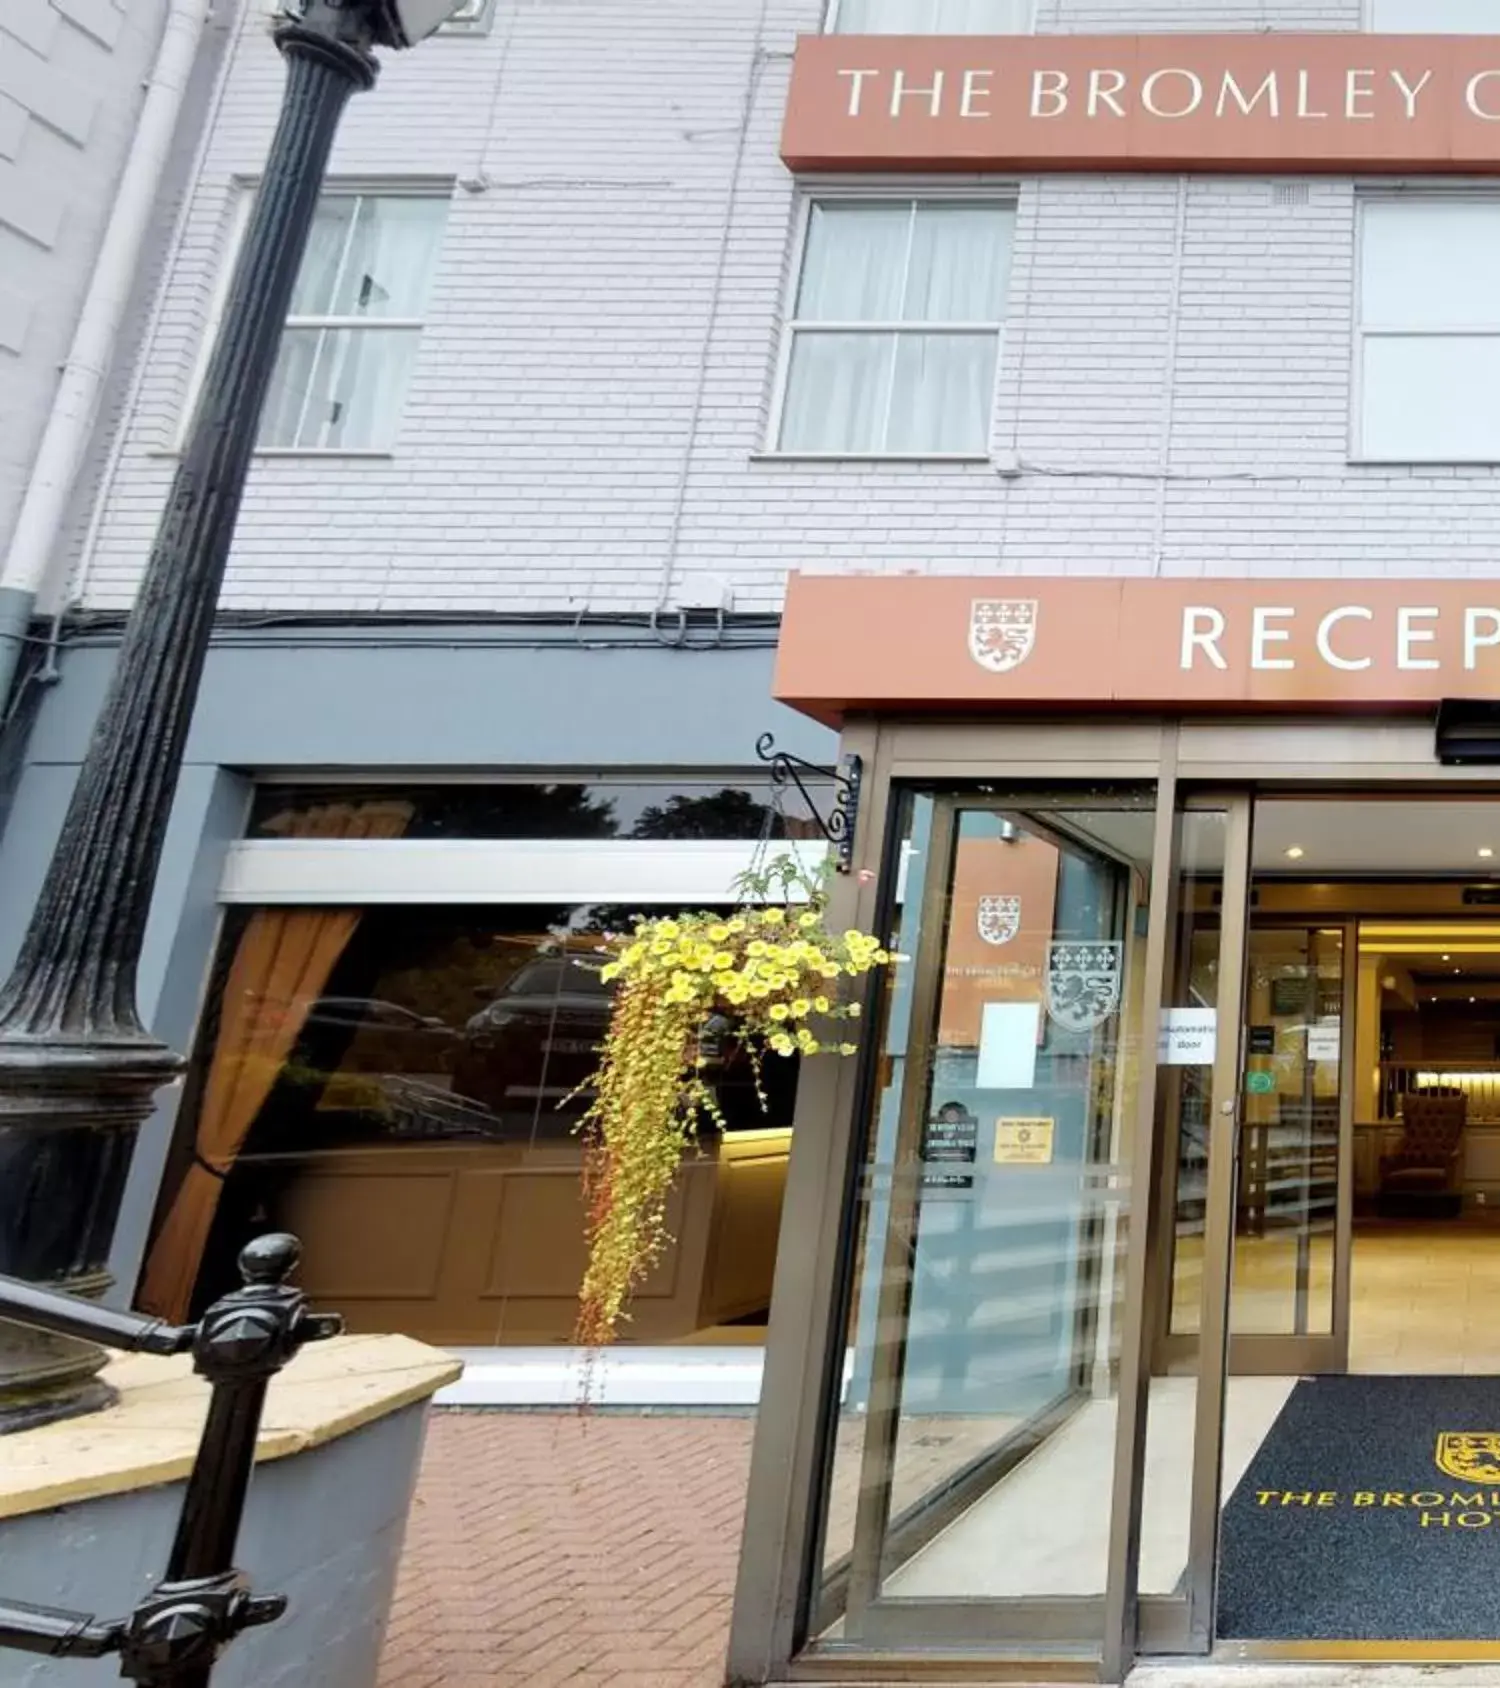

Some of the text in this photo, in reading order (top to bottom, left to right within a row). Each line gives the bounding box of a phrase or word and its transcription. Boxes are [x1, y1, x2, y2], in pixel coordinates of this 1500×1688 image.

[837, 69, 994, 117] THE
[1029, 68, 1432, 119] BROMLEY
[1256, 1490, 1337, 1506] THE
